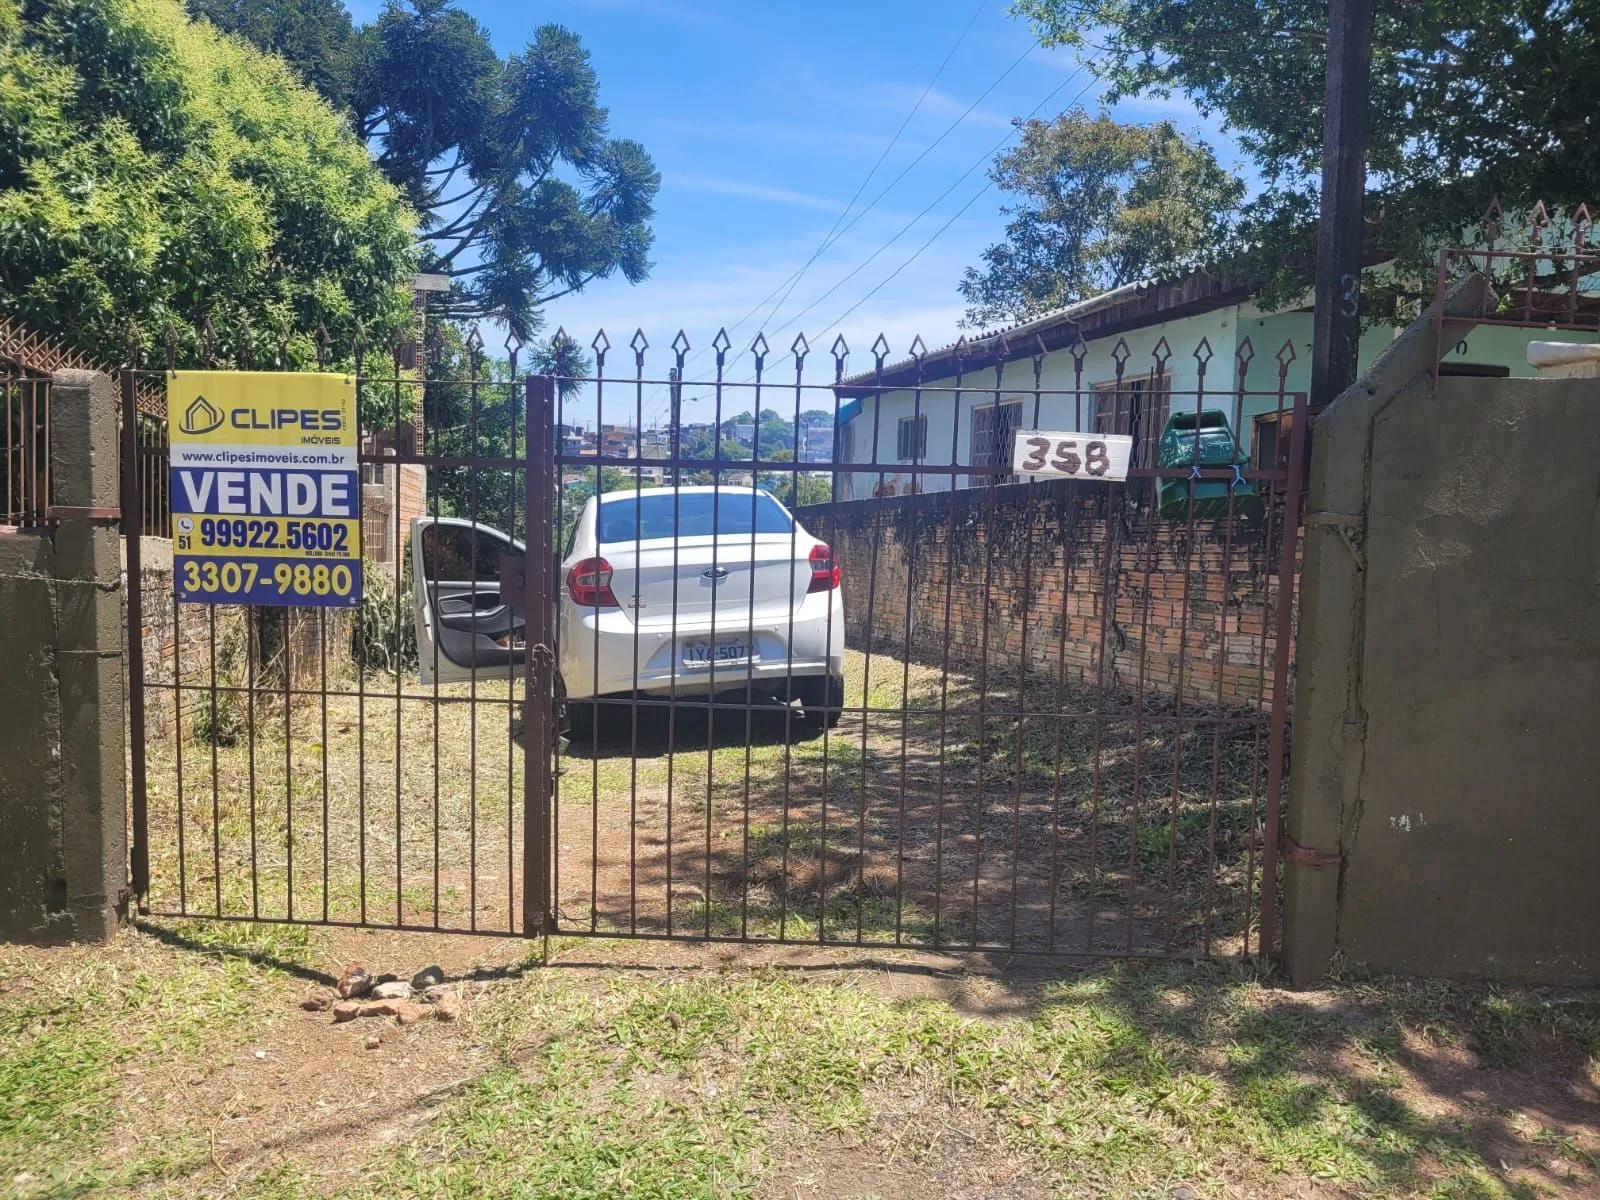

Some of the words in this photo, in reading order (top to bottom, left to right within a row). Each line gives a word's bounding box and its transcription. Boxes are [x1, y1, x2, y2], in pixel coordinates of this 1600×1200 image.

[230, 408, 342, 431] CLIPES
[300, 434, 341, 445] IMÓVEIS
[182, 450, 345, 465] www.clipesimoveis.com.br
[1022, 437, 1110, 476] 358
[180, 471, 350, 516] VENDE
[178, 535, 192, 550] 51
[200, 518, 348, 551] 99922.5602
[183, 560, 353, 596] 3307-9880
